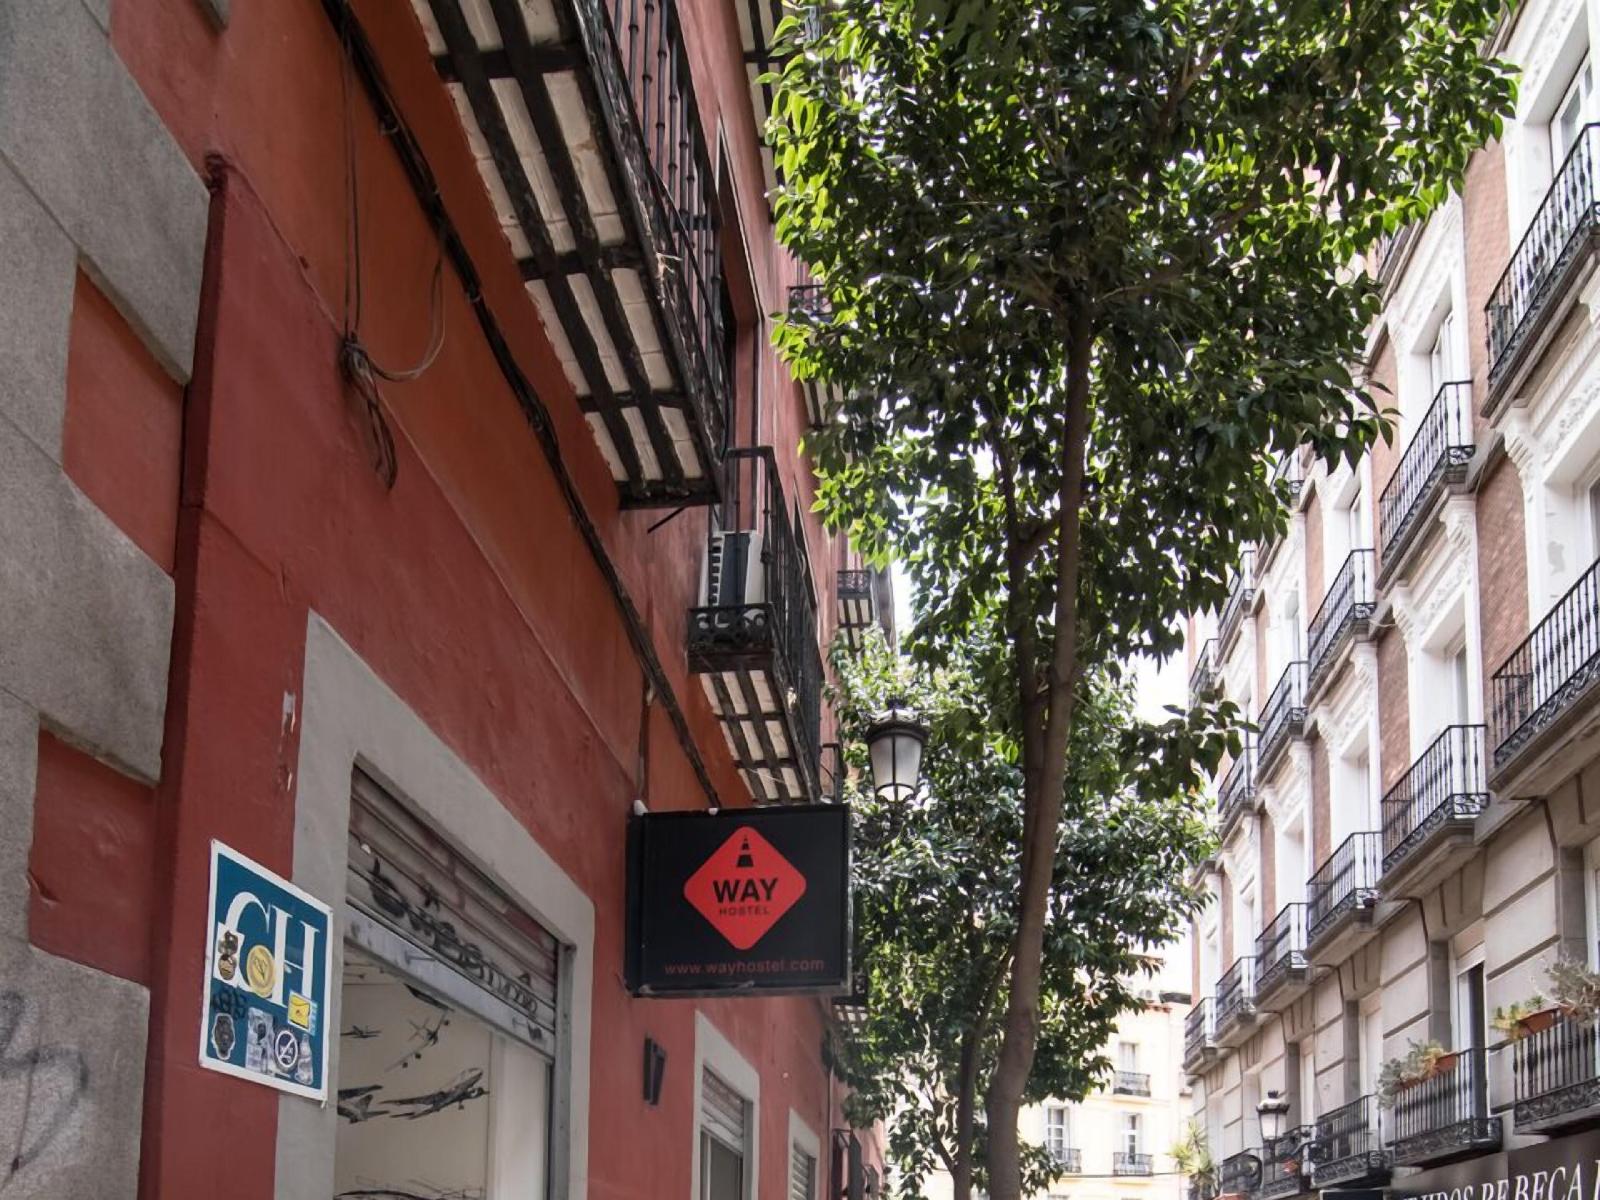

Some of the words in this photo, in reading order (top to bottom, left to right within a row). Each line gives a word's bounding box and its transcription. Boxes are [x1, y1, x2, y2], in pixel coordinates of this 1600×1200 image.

[713, 877, 779, 903] WAY
[719, 905, 770, 916] HOSTEL
[664, 958, 825, 976] www.wayhostel.com
